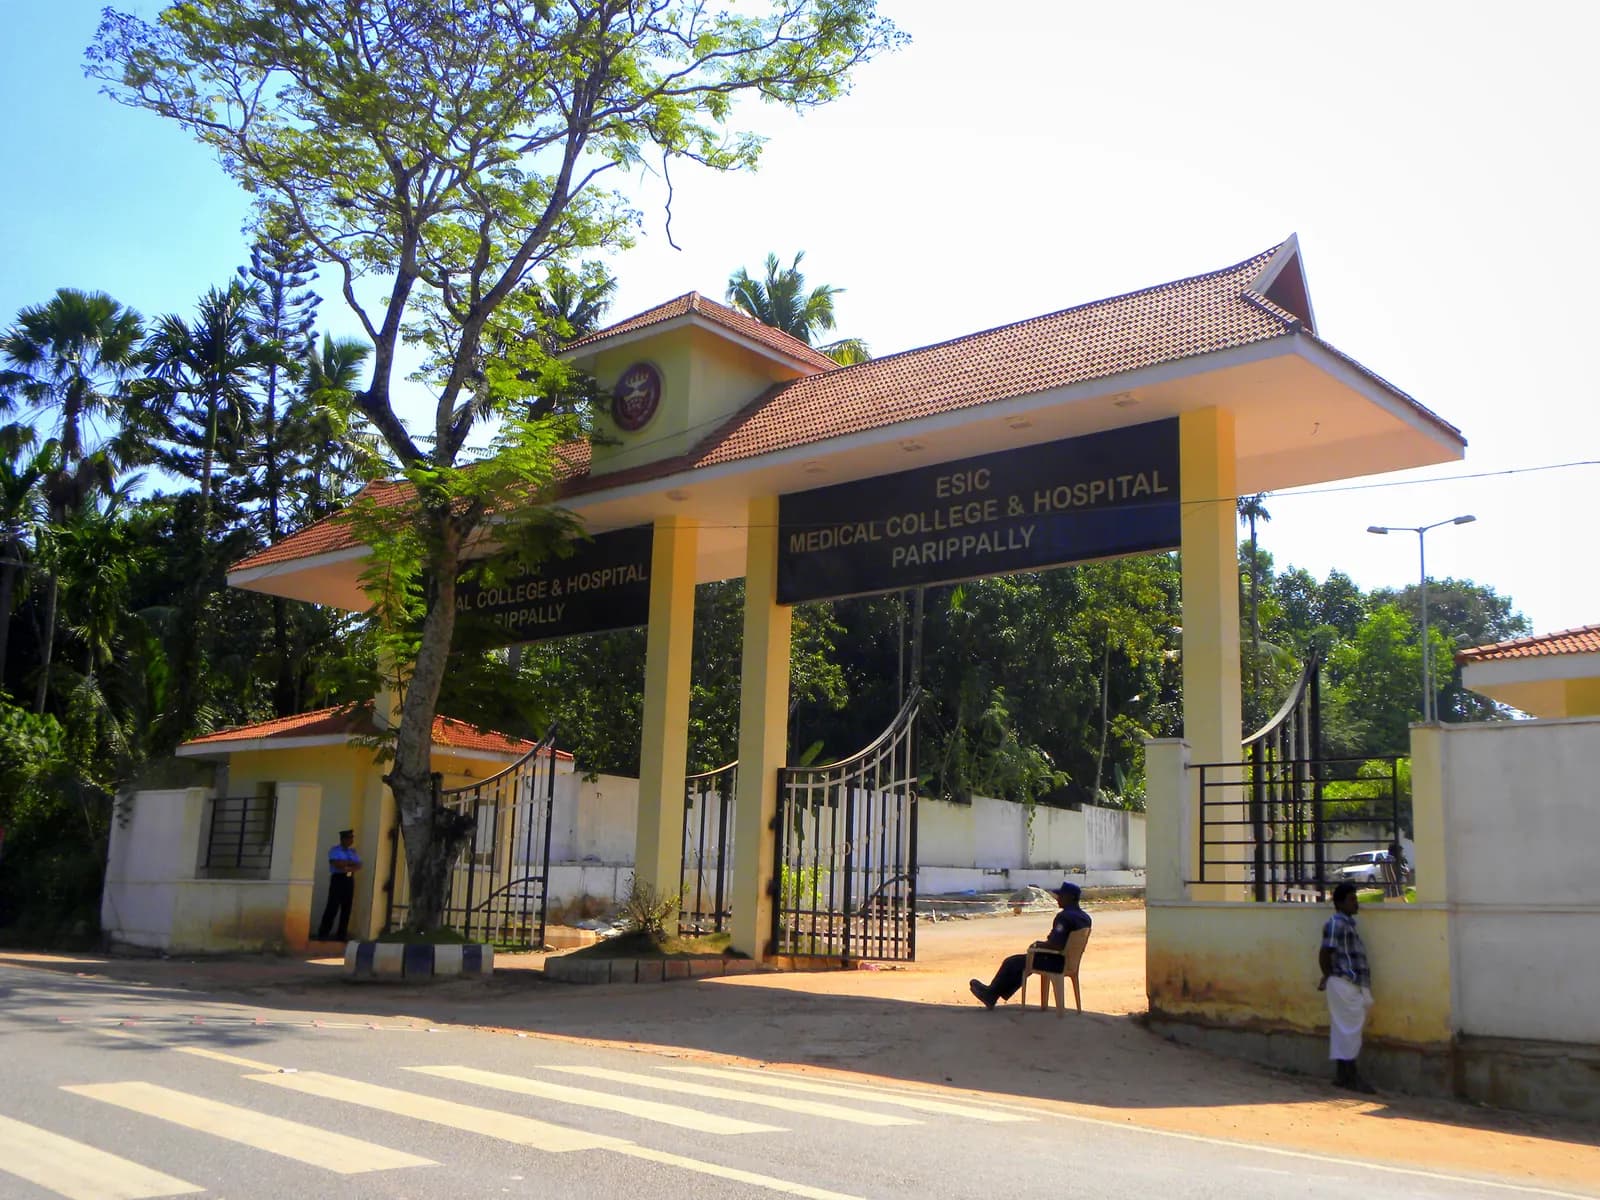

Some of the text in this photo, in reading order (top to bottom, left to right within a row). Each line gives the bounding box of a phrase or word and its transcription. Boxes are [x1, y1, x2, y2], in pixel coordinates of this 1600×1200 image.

[935, 468, 991, 499] ESIC
[790, 470, 1169, 554] MEDICAL COLLEGE & HOSPITAL
[892, 525, 1037, 569] PARIPPALLY
[476, 580, 549, 609] COLLEGE
[551, 578, 563, 597] &
[567, 564, 648, 594] HOSPITAL
